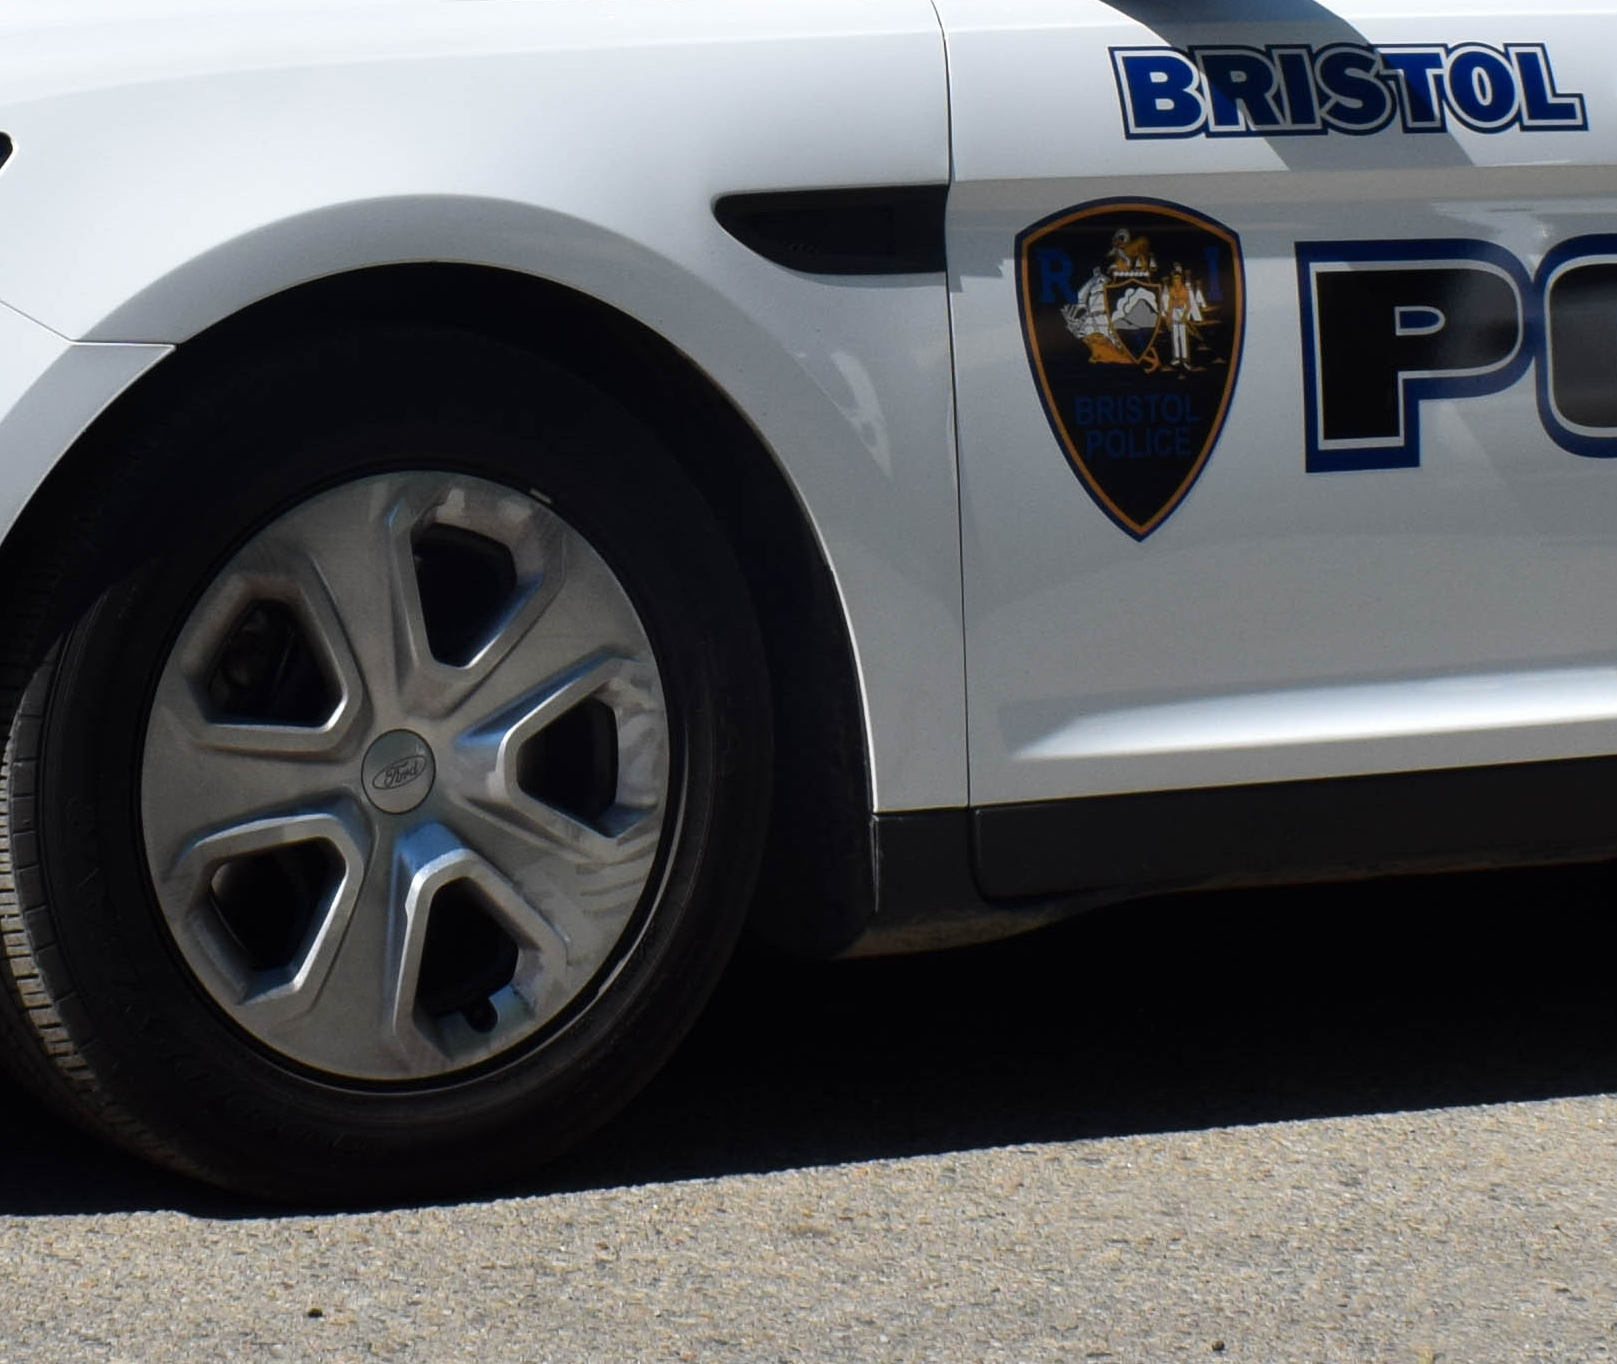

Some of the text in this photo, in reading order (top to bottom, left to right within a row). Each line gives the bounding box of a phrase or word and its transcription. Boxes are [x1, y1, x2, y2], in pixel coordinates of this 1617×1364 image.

[1108, 42, 1588, 139] BRISTOL
[1036, 246, 1078, 304] R
[1074, 393, 1199, 426] BRISTOL
[1085, 426, 1191, 460] POLICE
[381, 758, 424, 789] Ford
